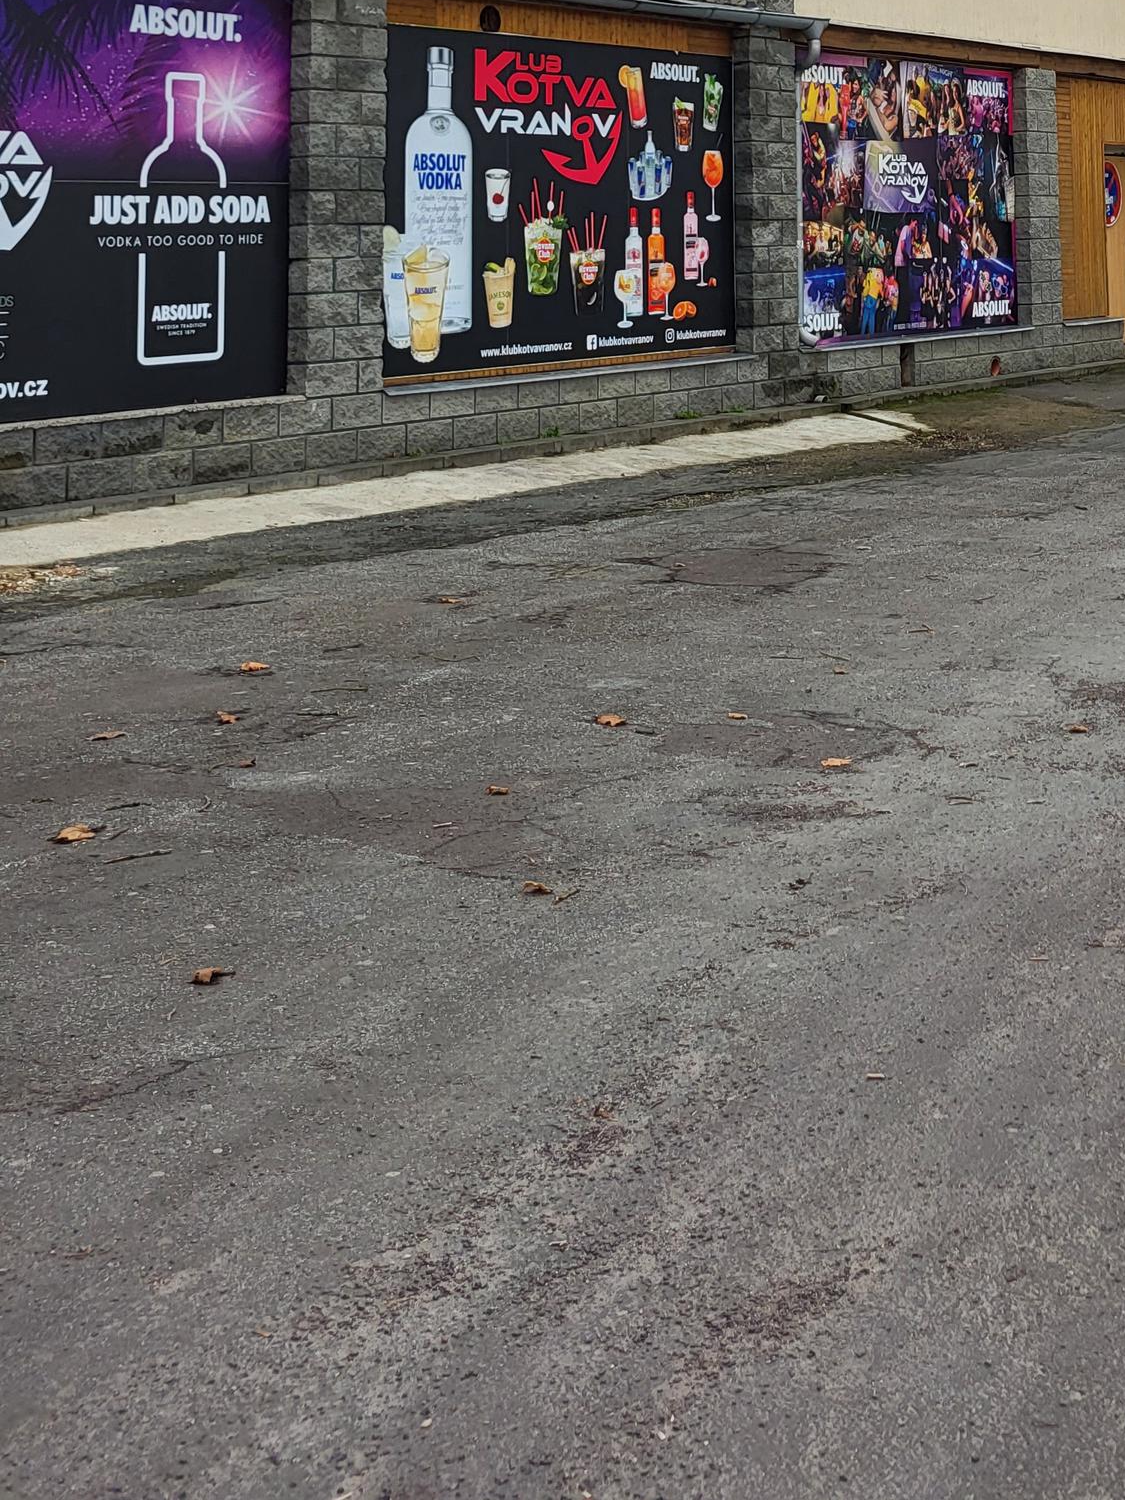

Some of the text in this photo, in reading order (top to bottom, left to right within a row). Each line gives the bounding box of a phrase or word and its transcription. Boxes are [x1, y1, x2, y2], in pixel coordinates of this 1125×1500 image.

[474, 102, 617, 141] VRANOV
[413, 153, 466, 172] ABSOLUT
[418, 172, 462, 190] VODKA
[879, 173, 926, 187] VRANOV
[89, 195, 271, 225] JUST ADD SODA
[97, 233, 264, 248] VODKA TOO GOOD TO HIDE
